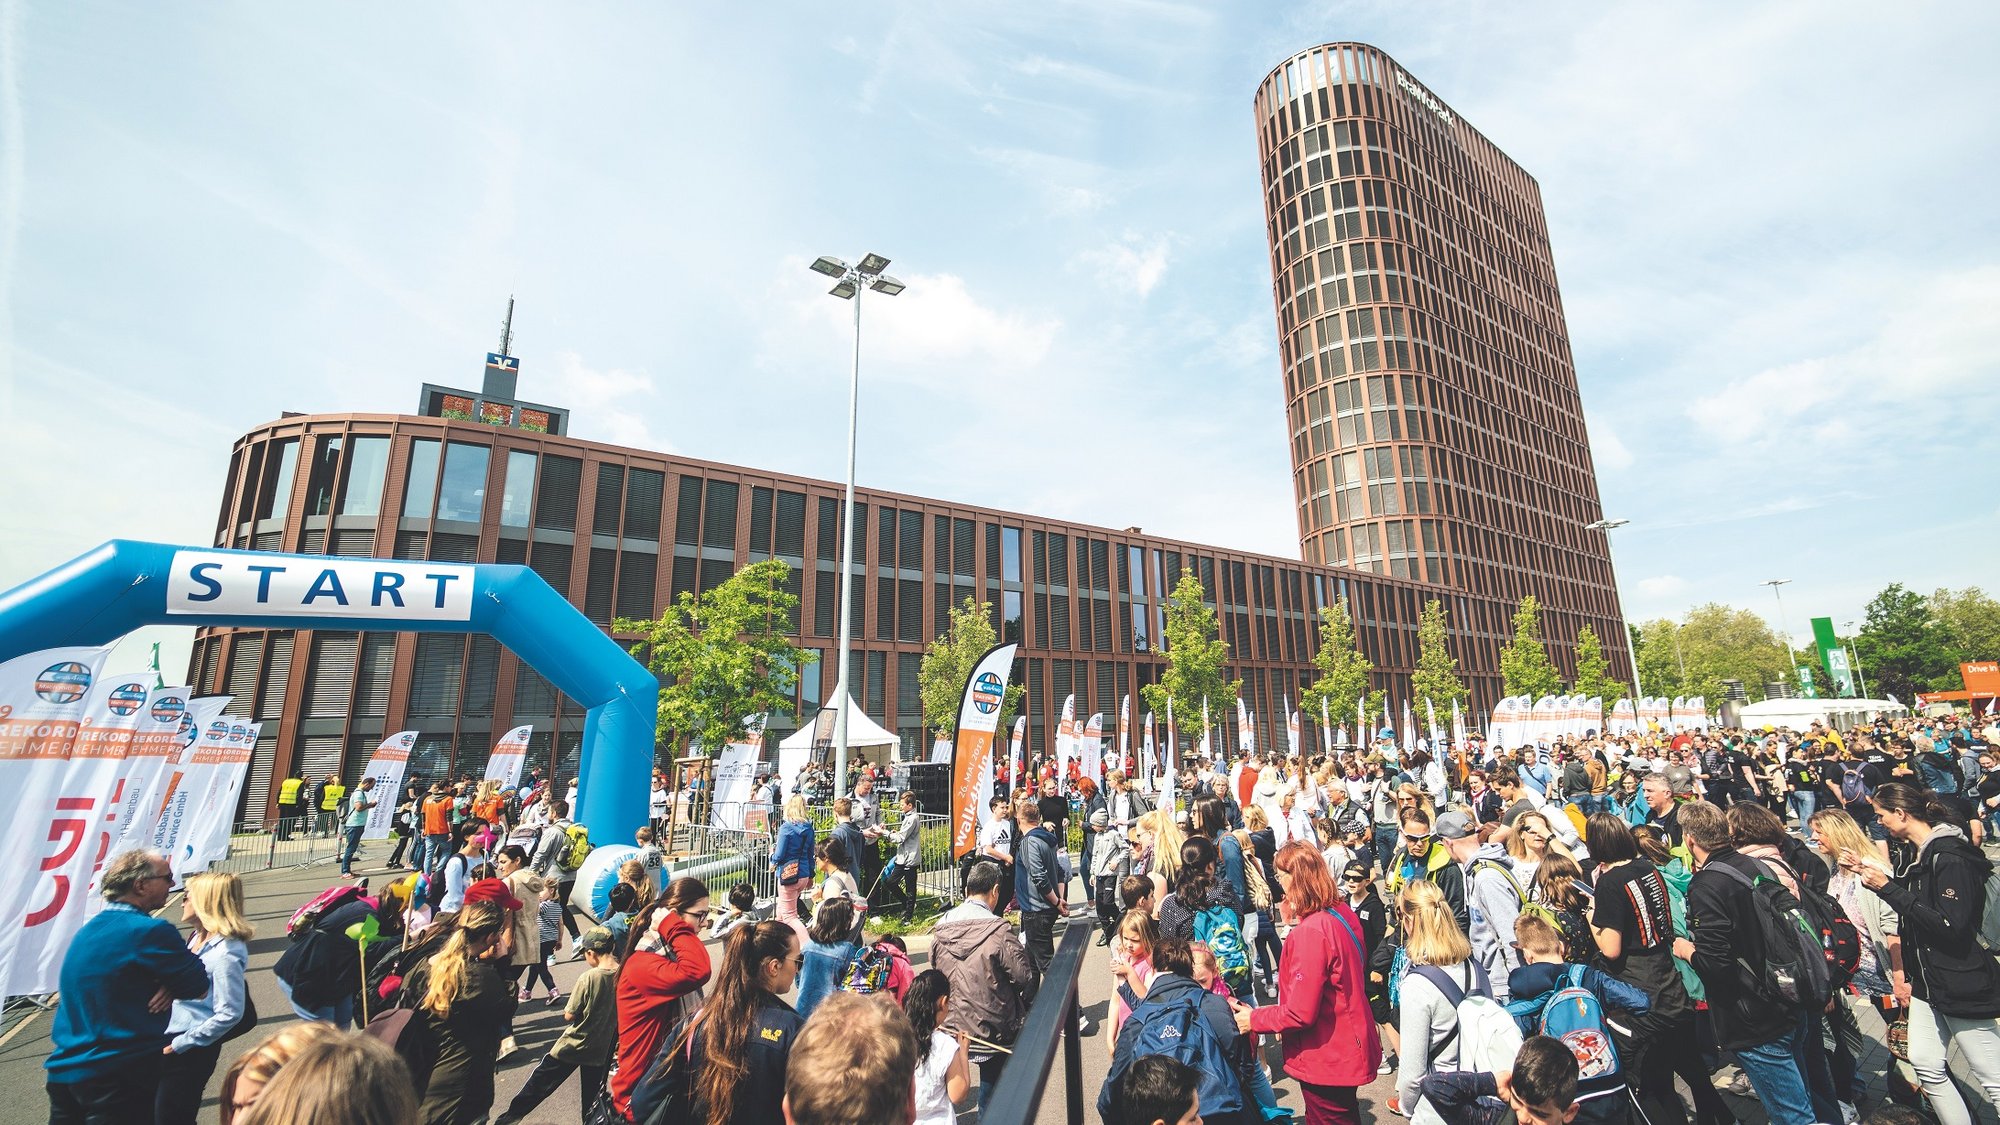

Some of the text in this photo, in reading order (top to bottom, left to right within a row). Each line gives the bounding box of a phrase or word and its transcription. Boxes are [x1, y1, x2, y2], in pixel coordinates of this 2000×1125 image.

[1396, 70, 1455, 128] BraWoPark
[187, 562, 459, 609] START
[1967, 664, 1998, 674] Drive In
[971, 737, 985, 761] 2019
[1538, 740, 1550, 765] DIE
[963, 762, 976, 783] MAI
[958, 784, 969, 799] 26.
[121, 788, 141, 830] Hallenbau
[165, 791, 189, 850] Service GmbH
[24, 797, 96, 927] CGI
